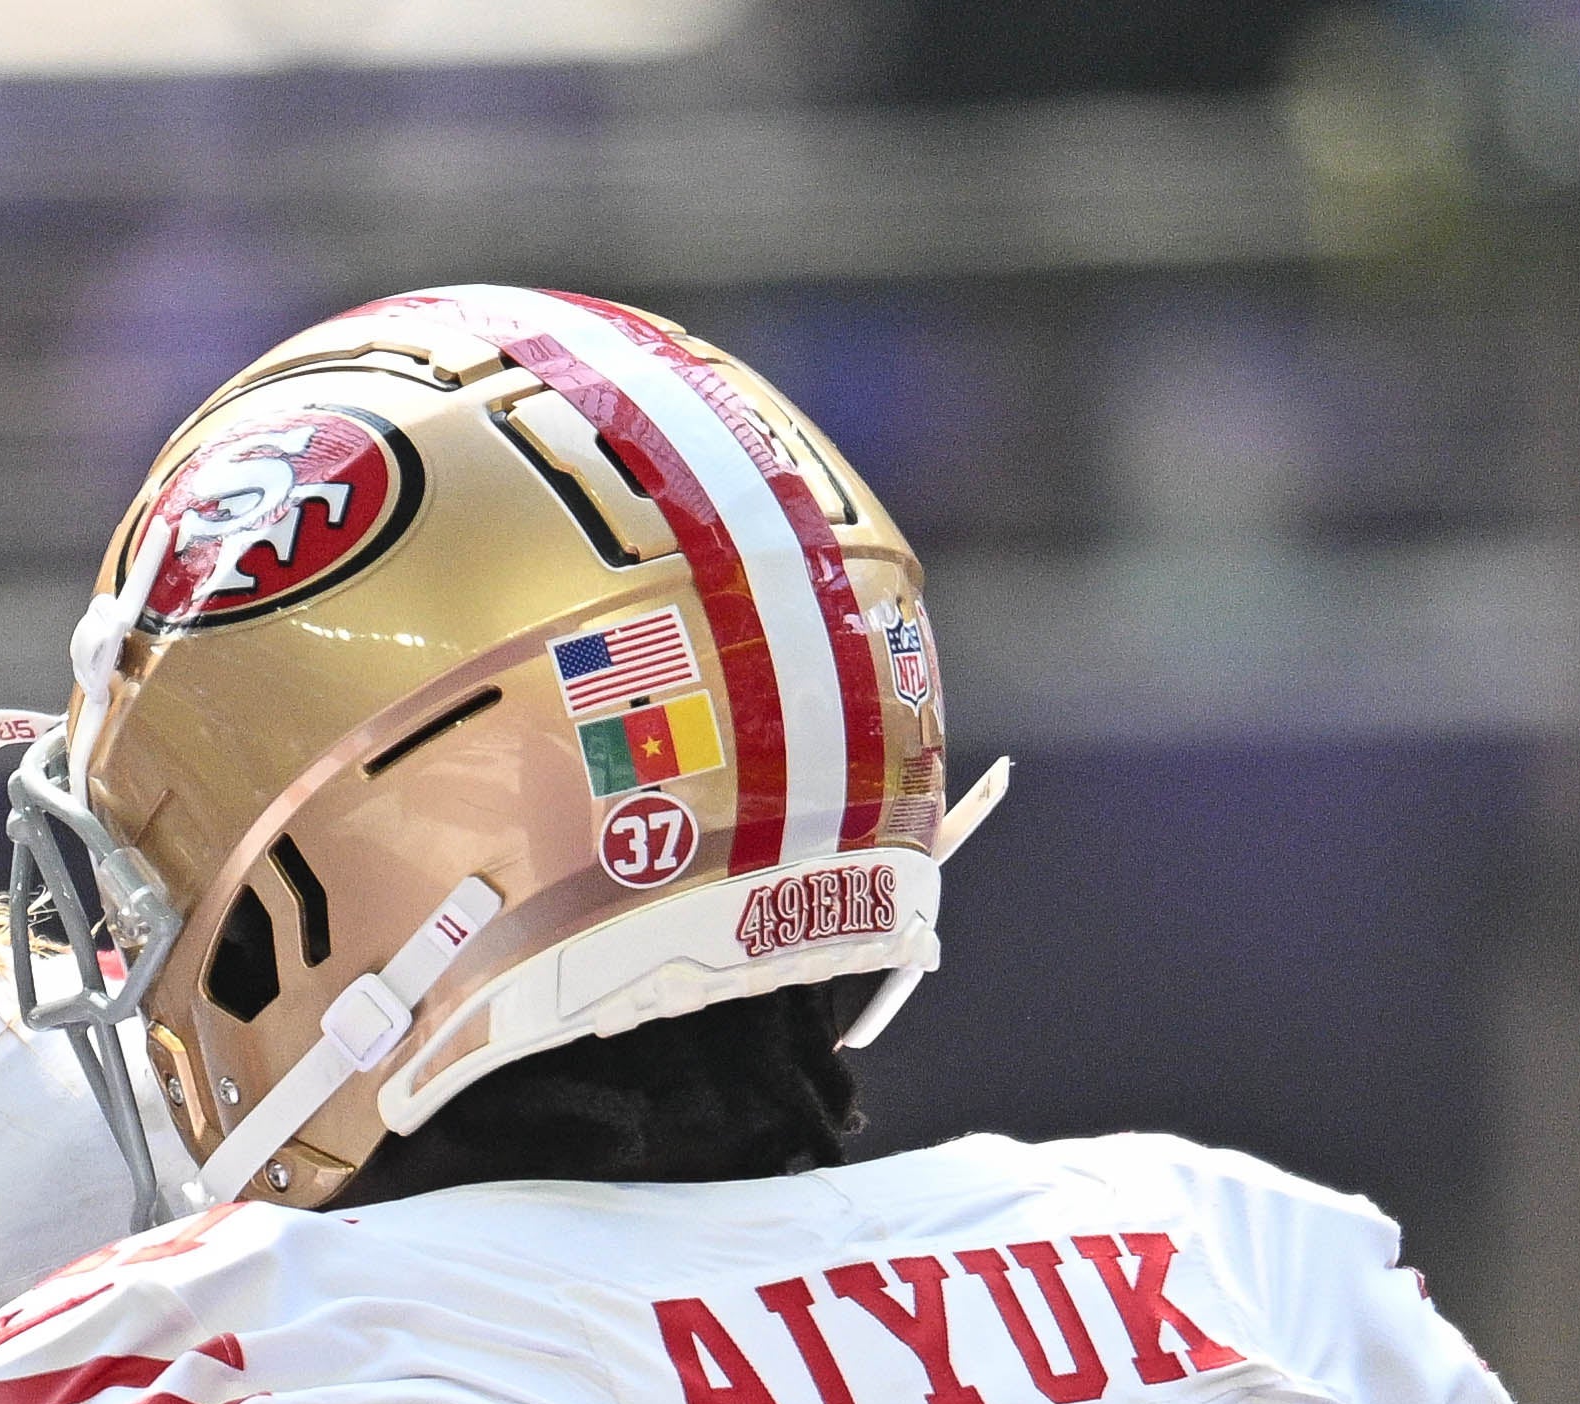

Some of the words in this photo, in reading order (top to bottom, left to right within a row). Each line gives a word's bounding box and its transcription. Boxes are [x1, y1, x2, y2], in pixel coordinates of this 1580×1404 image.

[611, 809, 682, 875] 37
[435, 914, 468, 946] 11
[737, 864, 897, 957] 49ERS
